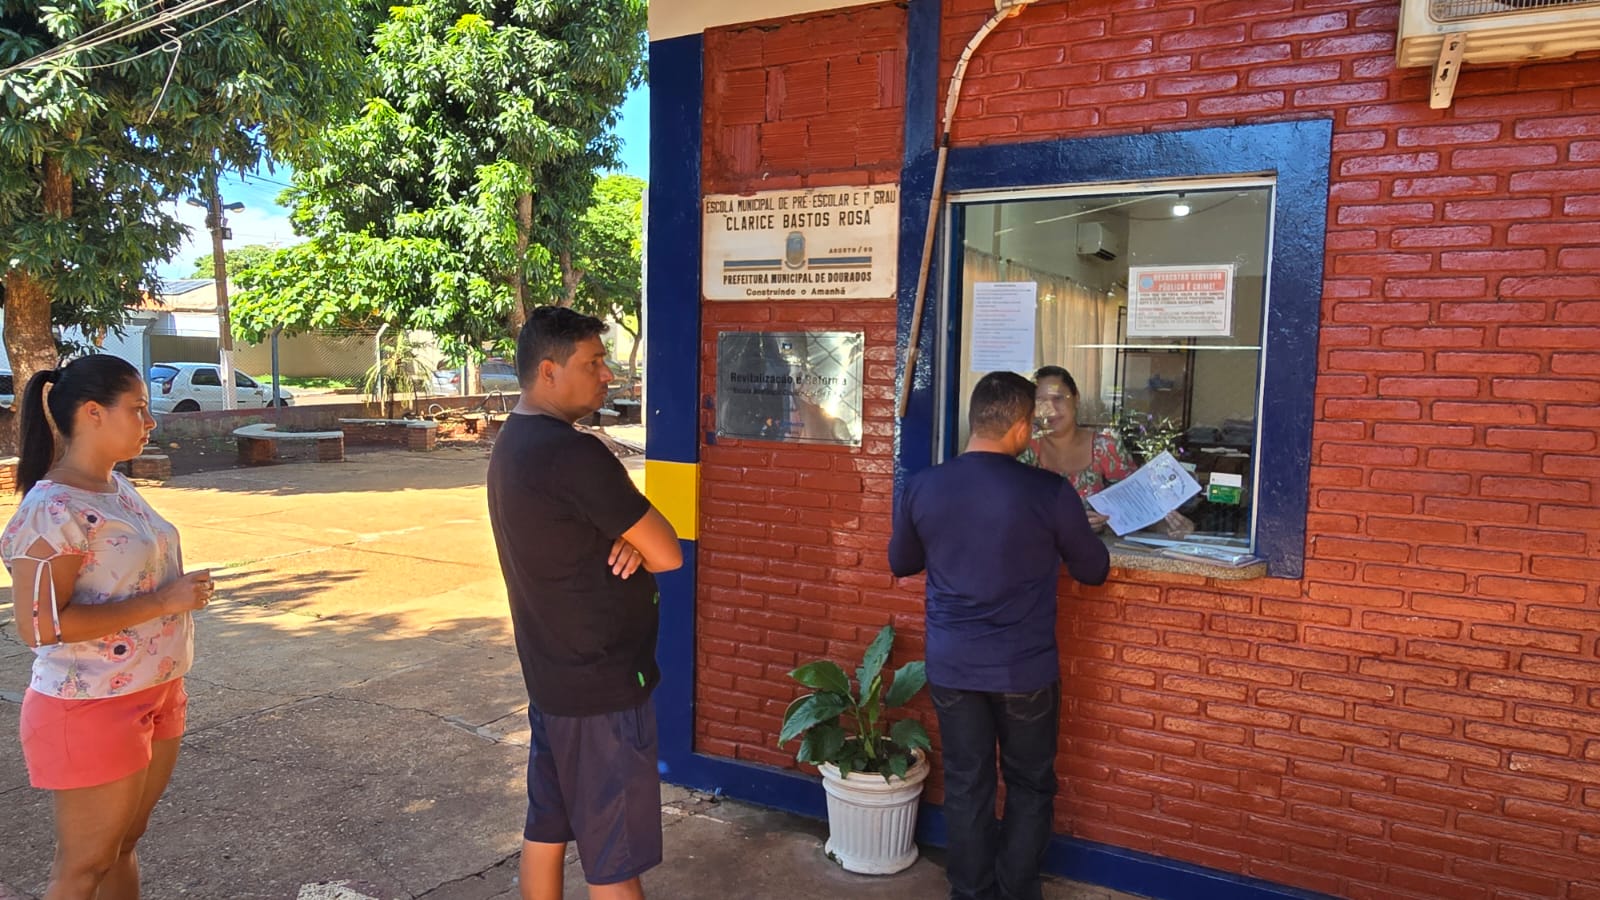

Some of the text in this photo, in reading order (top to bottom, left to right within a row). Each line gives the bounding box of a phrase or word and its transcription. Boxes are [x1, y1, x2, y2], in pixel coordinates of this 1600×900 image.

[706, 200, 734, 214] ESCOLA
[737, 198, 775, 212] MUNICIPAL
[778, 197, 789, 210] DE
[853, 193, 860, 206] E
[873, 190, 896, 205] GRAU
[783, 212, 830, 229] BASTOS
[723, 272, 872, 285] PREFEITURA MUNICIPAL DE DOURADOS
[746, 288, 796, 296] Construindo
[796, 377, 802, 385] e
